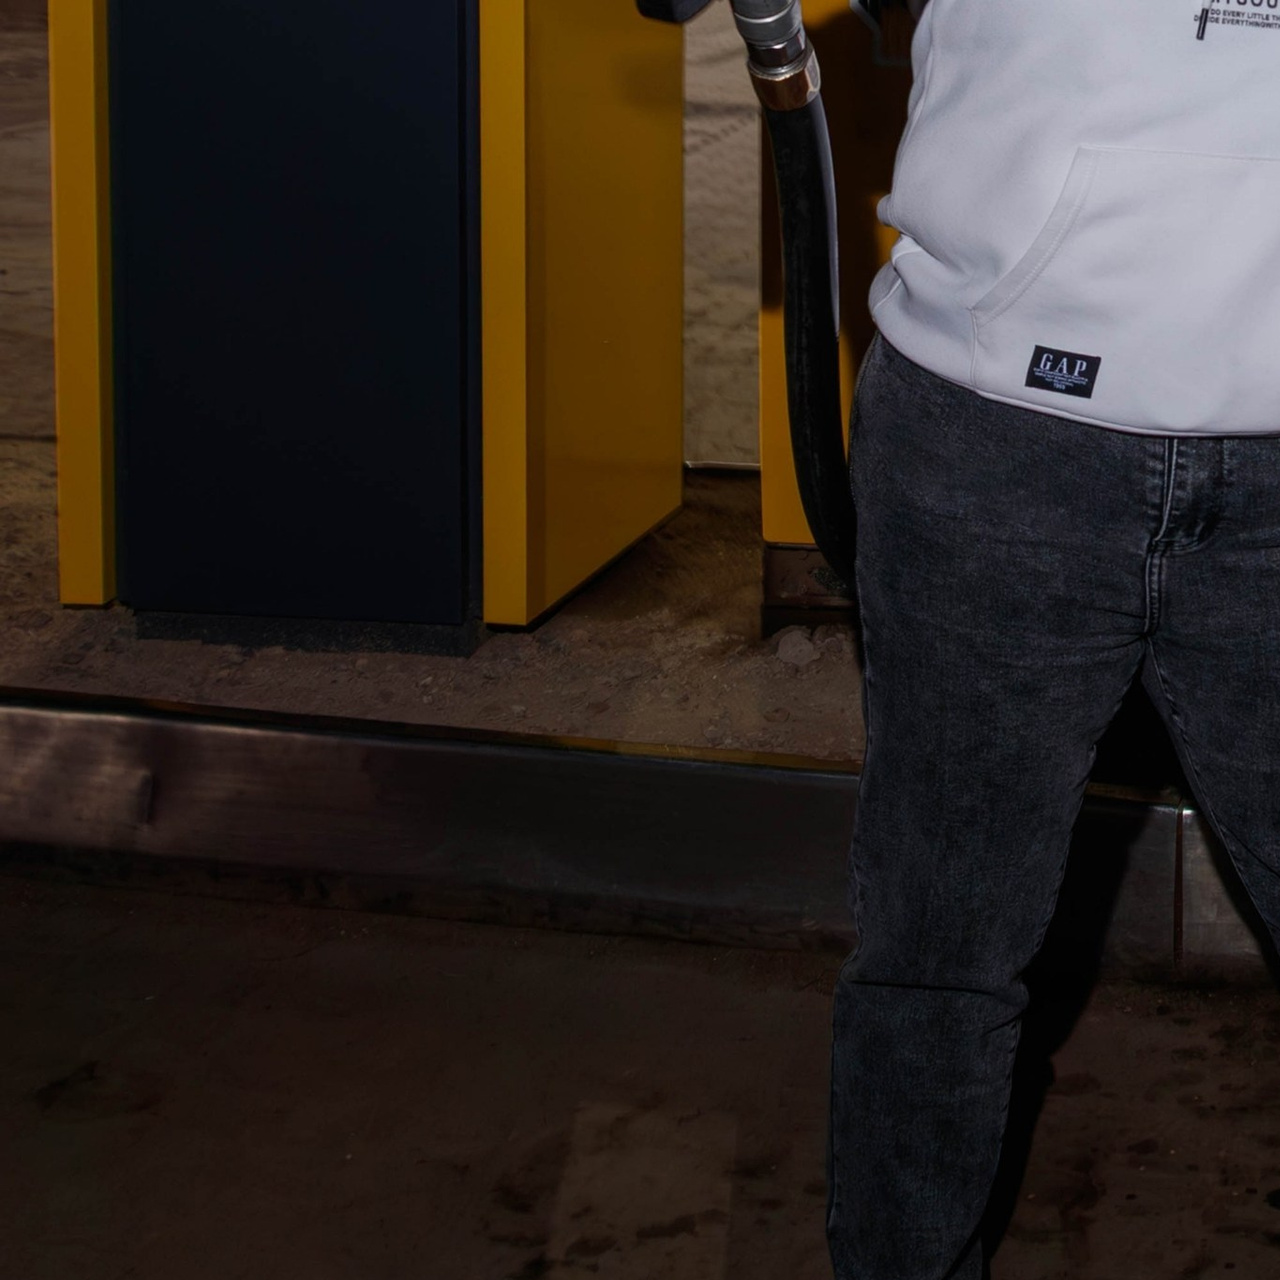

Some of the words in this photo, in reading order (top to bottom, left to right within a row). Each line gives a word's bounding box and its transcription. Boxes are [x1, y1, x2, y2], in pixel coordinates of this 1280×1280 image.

[1222, 10, 1245, 18] EVERY
[1247, 12, 1269, 21] LITTLE
[1040, 353, 1087, 377] GAP
